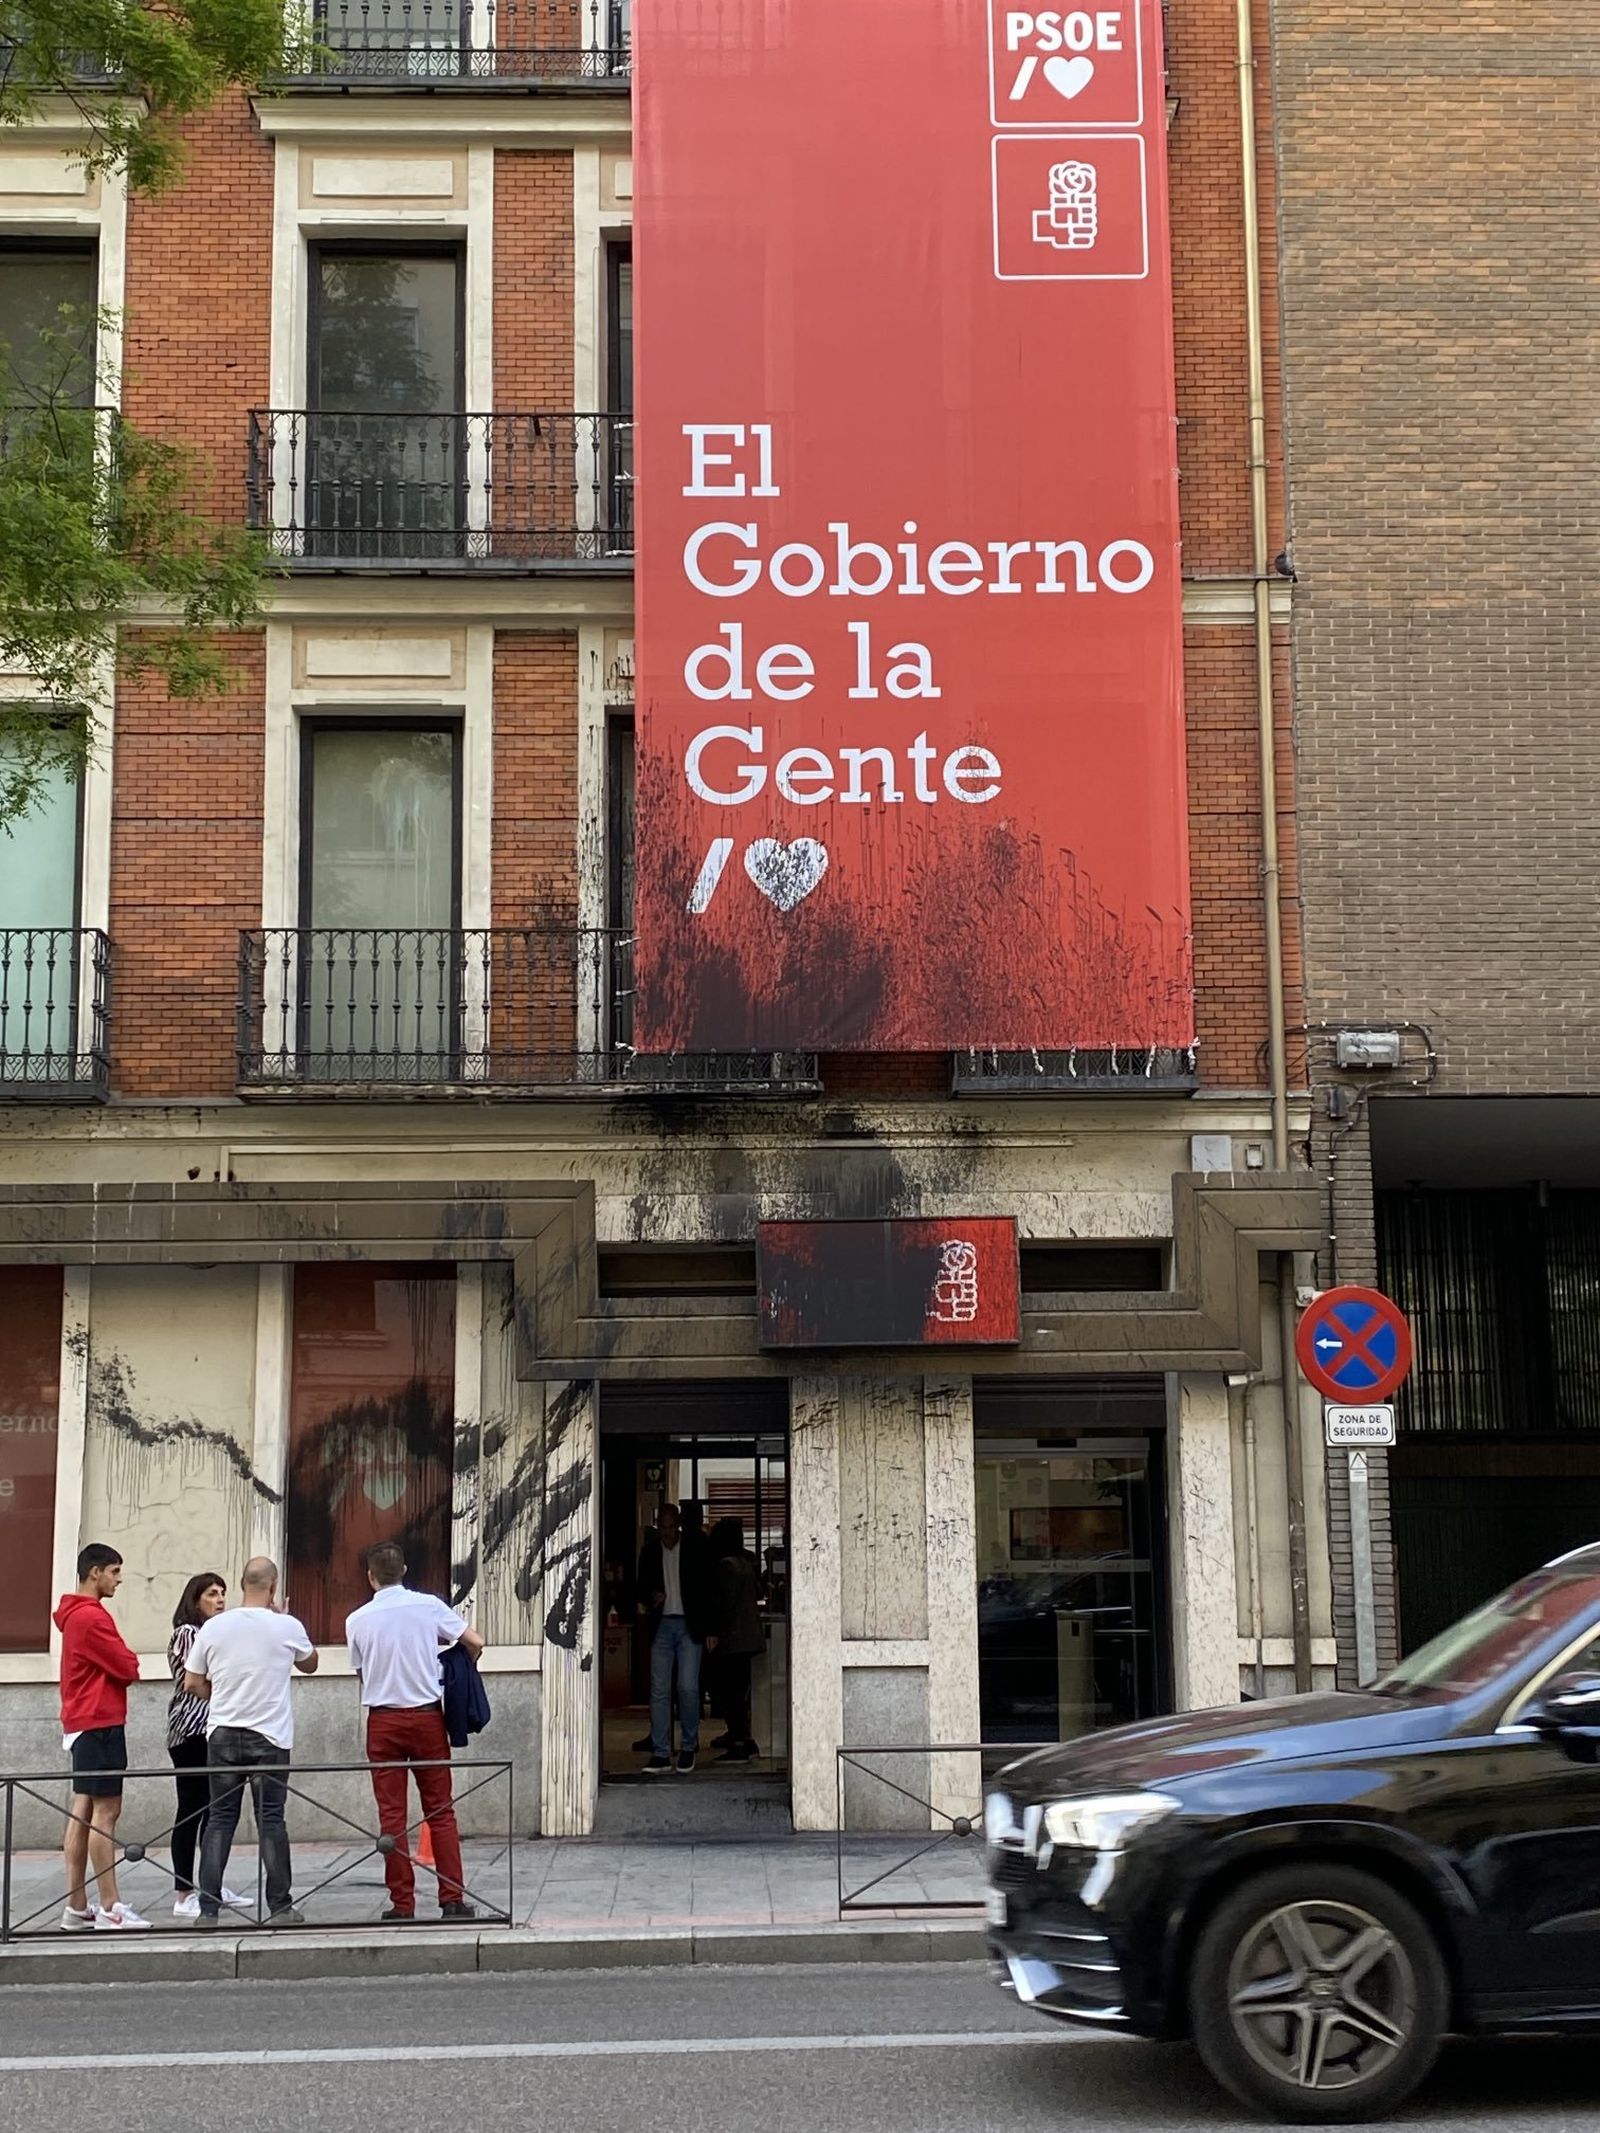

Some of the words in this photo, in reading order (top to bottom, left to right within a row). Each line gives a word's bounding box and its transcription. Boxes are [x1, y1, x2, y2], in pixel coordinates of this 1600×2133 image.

[1007, 12, 1122, 52] PSOE
[683, 425, 781, 497] El
[684, 521, 1154, 597] Gobierno
[685, 623, 815, 701] de
[848, 622, 942, 699] la
[685, 726, 1002, 805] Gente
[1333, 1426, 1389, 1437] SEGURIDAD
[1338, 1414, 1366, 1424] ZONA
[1368, 1414, 1382, 1424] DE
